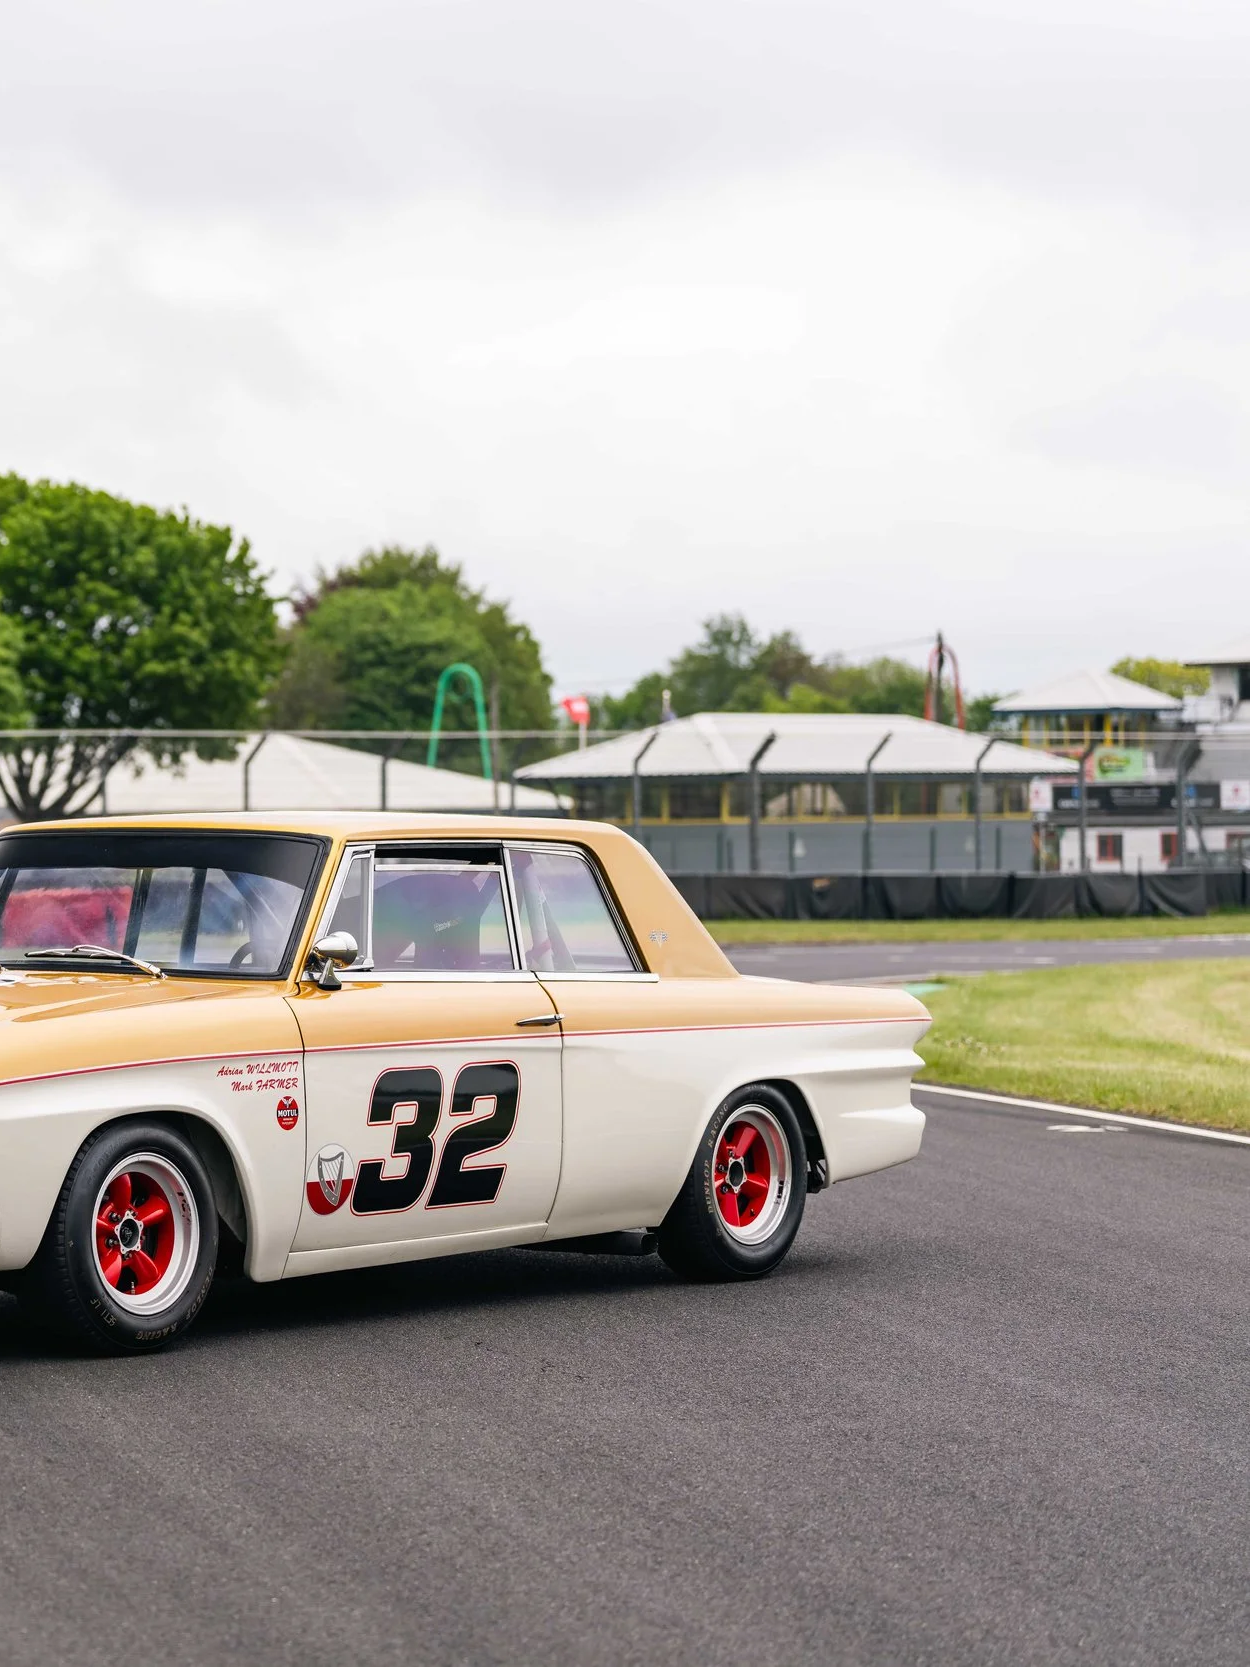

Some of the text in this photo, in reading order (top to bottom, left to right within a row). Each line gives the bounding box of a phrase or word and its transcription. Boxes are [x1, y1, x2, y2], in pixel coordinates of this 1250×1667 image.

[216, 1061, 299, 1077] Adrian WILLMOTT
[231, 1078, 298, 1092] Mark FARMER
[278, 1109, 298, 1117] MOTUL
[350, 1060, 521, 1216] 32
[703, 1104, 729, 1213] DUNLOP RACING
